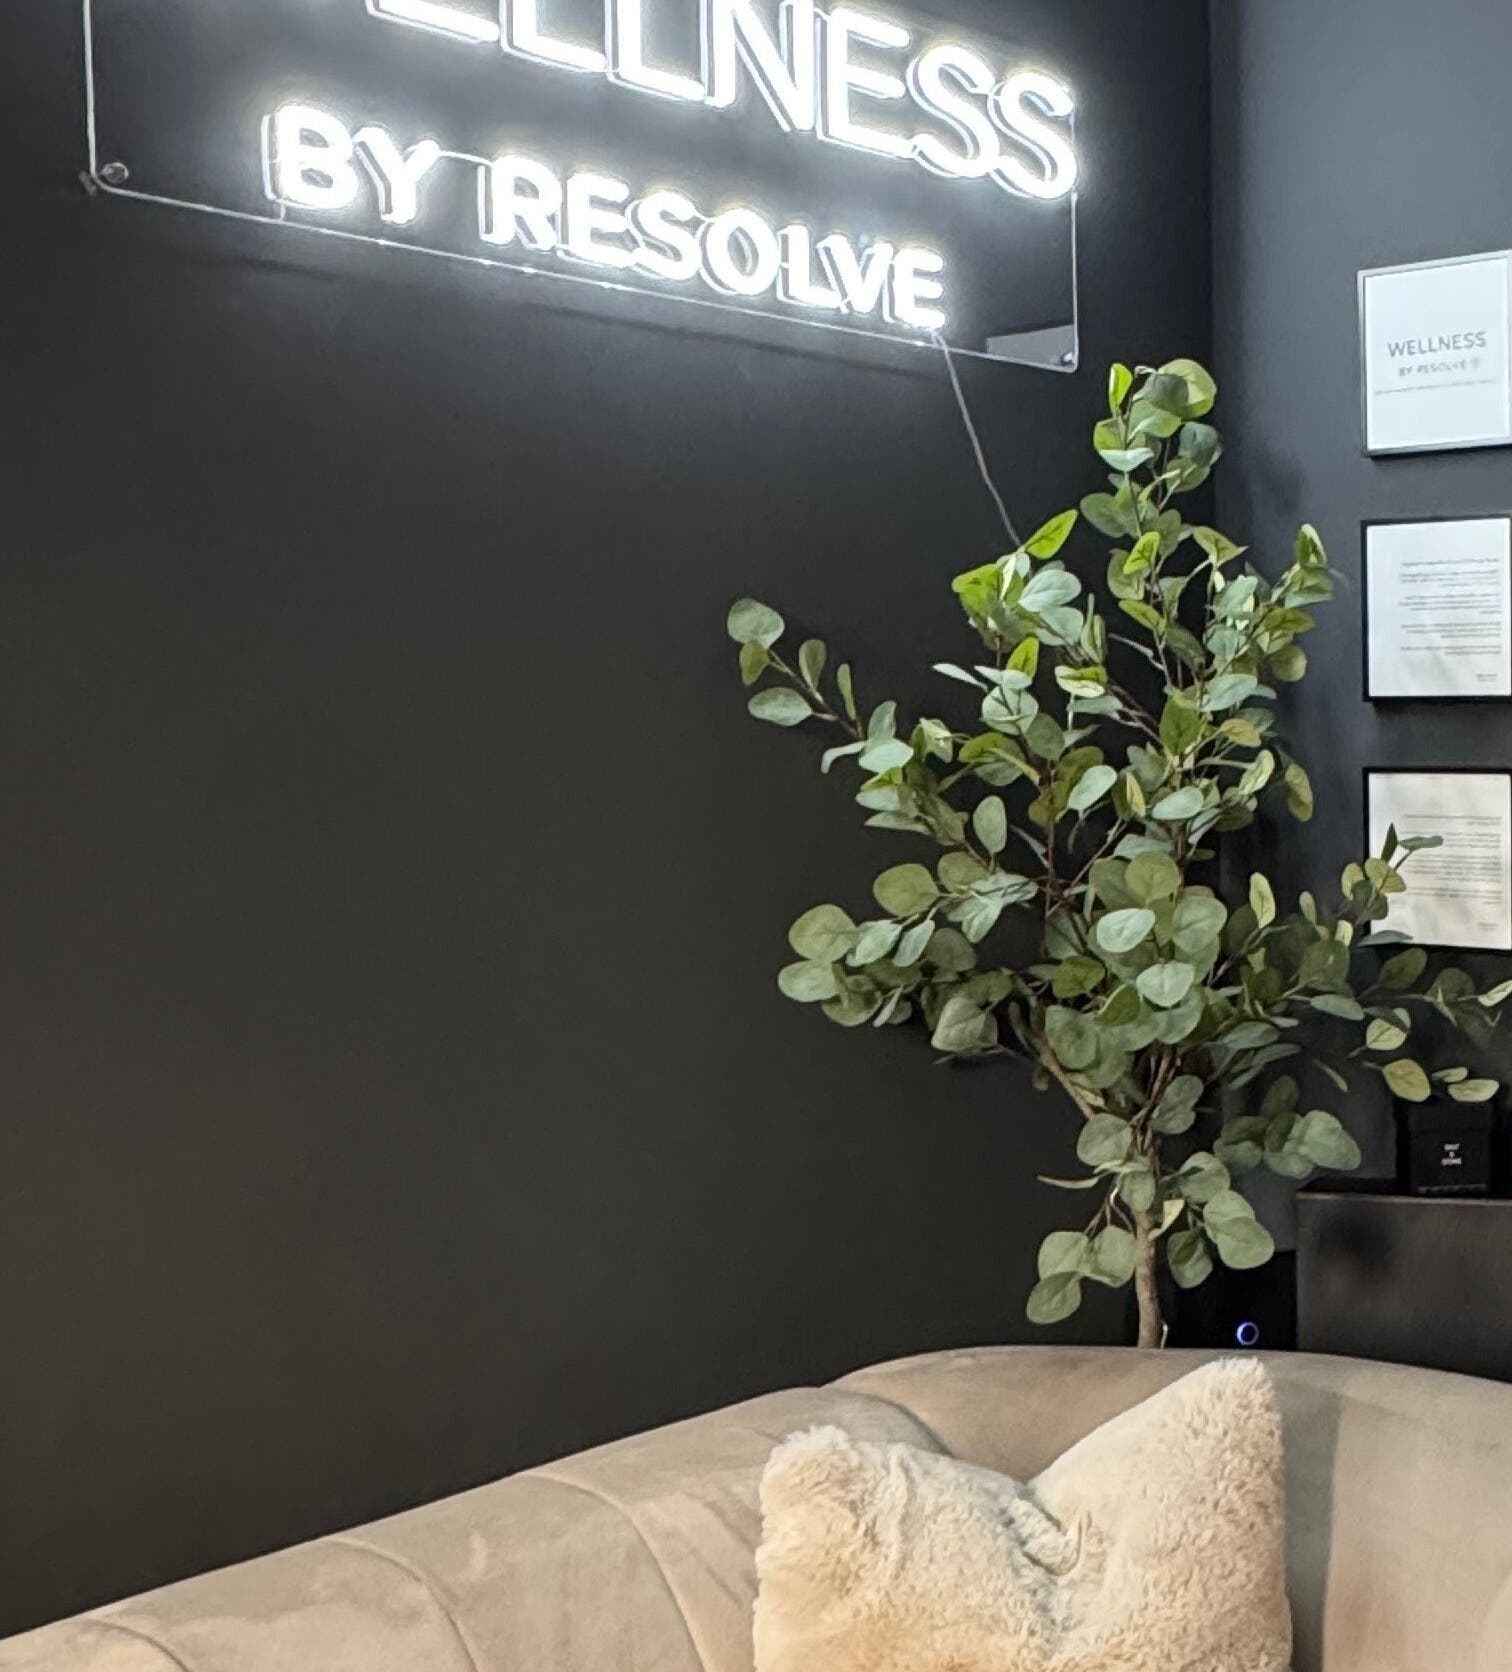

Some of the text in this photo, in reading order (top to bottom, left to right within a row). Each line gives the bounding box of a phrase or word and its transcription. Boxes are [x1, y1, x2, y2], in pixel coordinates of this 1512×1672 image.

[261, 103, 947, 331] BY RESOLVE
[1387, 331, 1487, 357] WELLNESS
